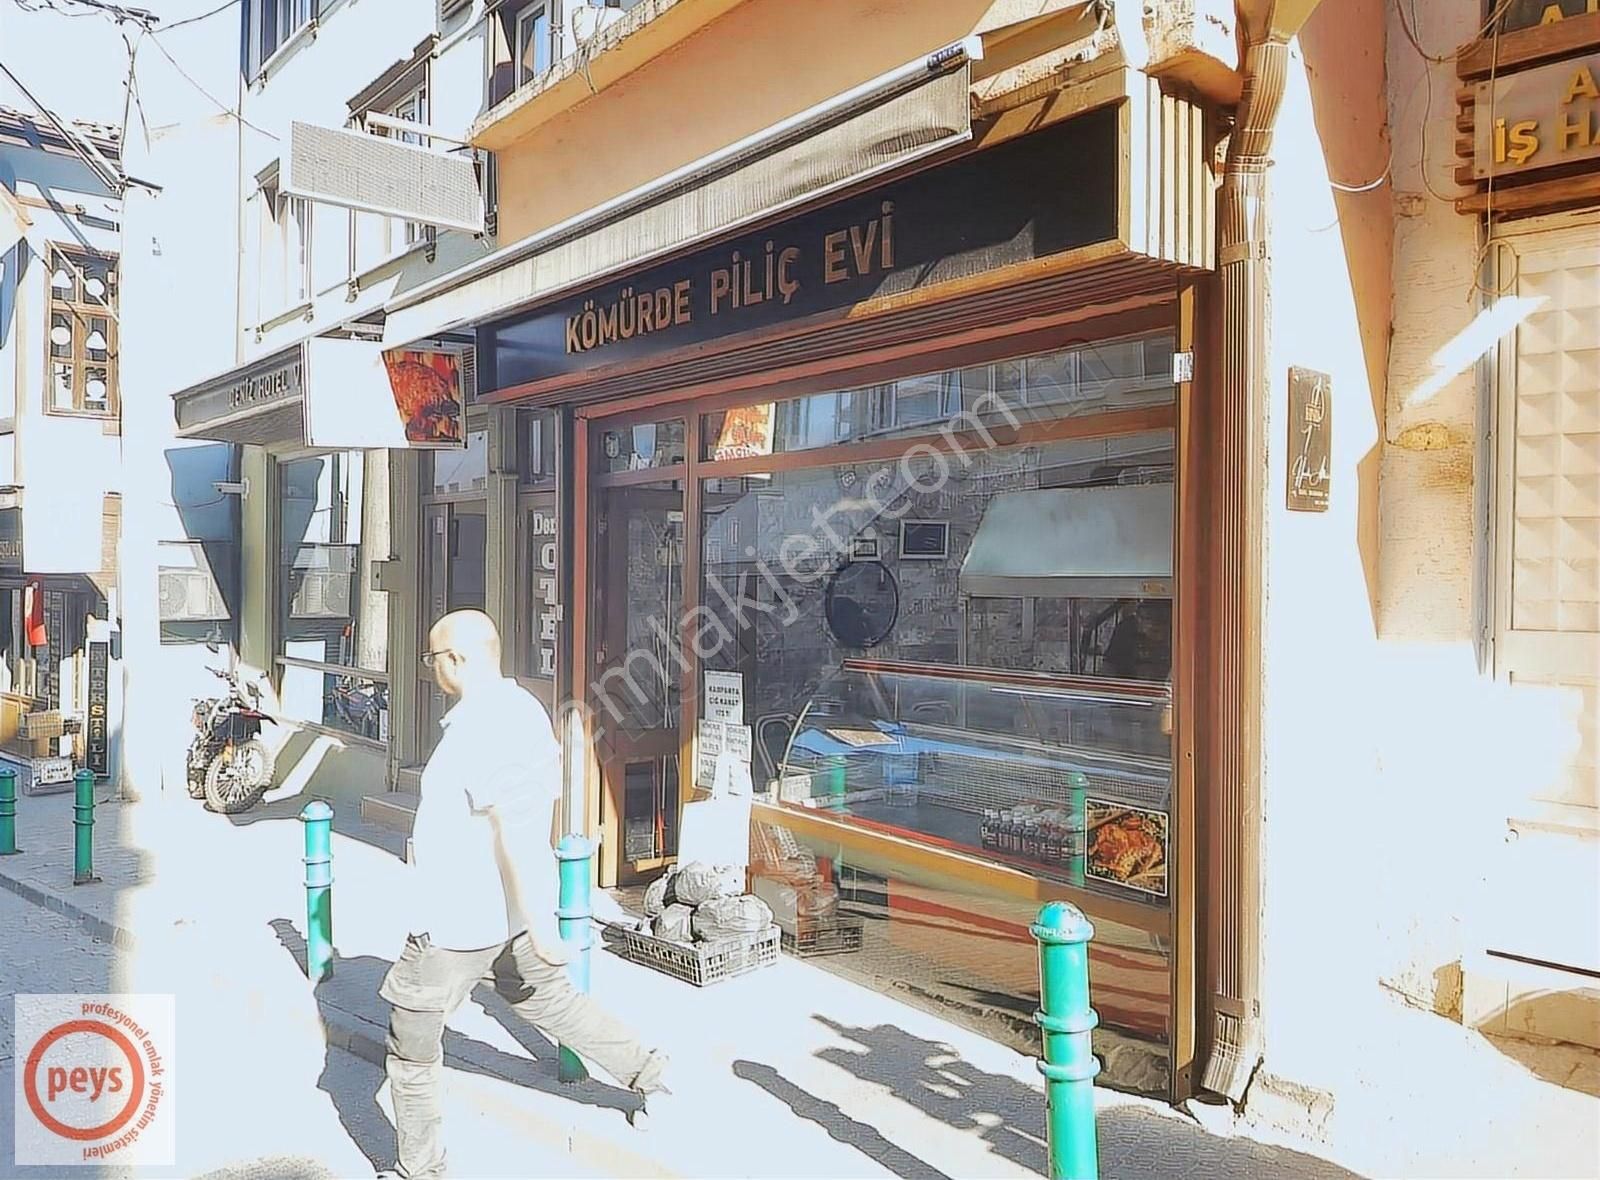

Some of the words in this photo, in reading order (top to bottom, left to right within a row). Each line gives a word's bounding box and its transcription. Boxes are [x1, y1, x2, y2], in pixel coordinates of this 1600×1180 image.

[1495, 118, 1541, 165] İŞ
[1557, 110, 1600, 152] H
[565, 279, 692, 354] KÖMÜRDE
[709, 240, 801, 315] PİLİÇ
[823, 200, 897, 284] EVİ
[258, 368, 288, 398] HOTEL
